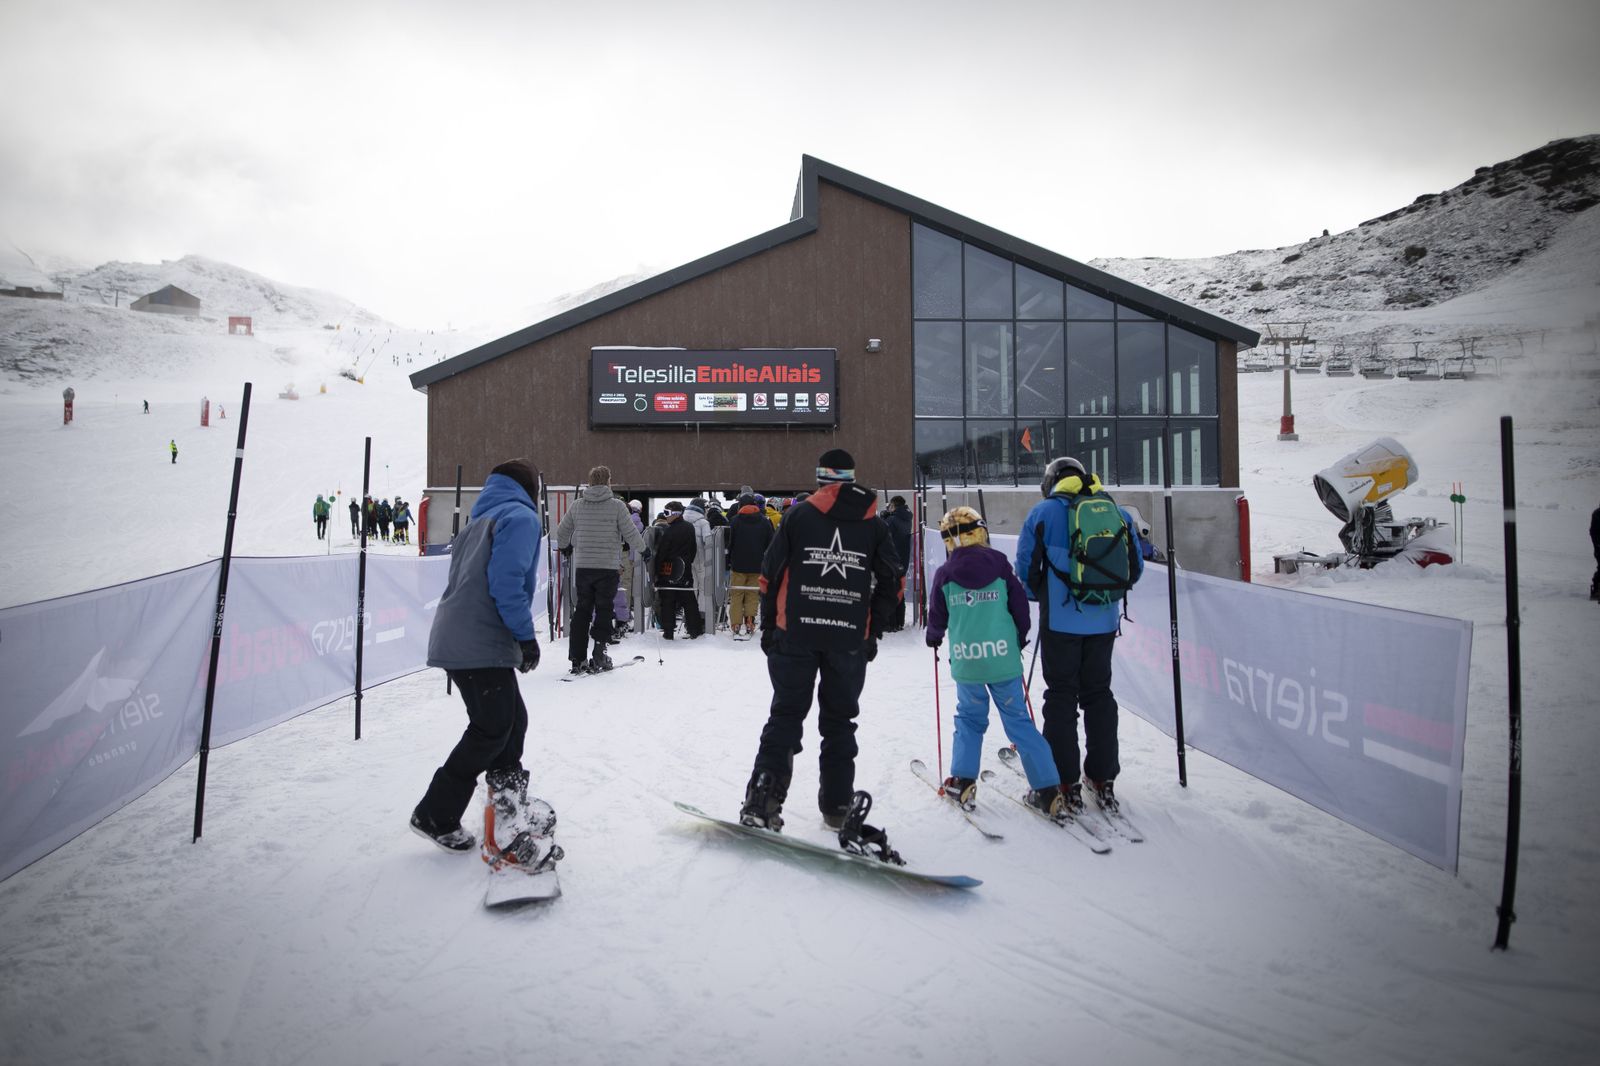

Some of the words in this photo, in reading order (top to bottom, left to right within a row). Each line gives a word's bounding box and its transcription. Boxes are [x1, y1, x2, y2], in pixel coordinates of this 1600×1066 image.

[809, 552, 860, 564] TELEMARK
[801, 584, 862, 599] Beauty-sports.com
[952, 639, 1009, 660] etone
